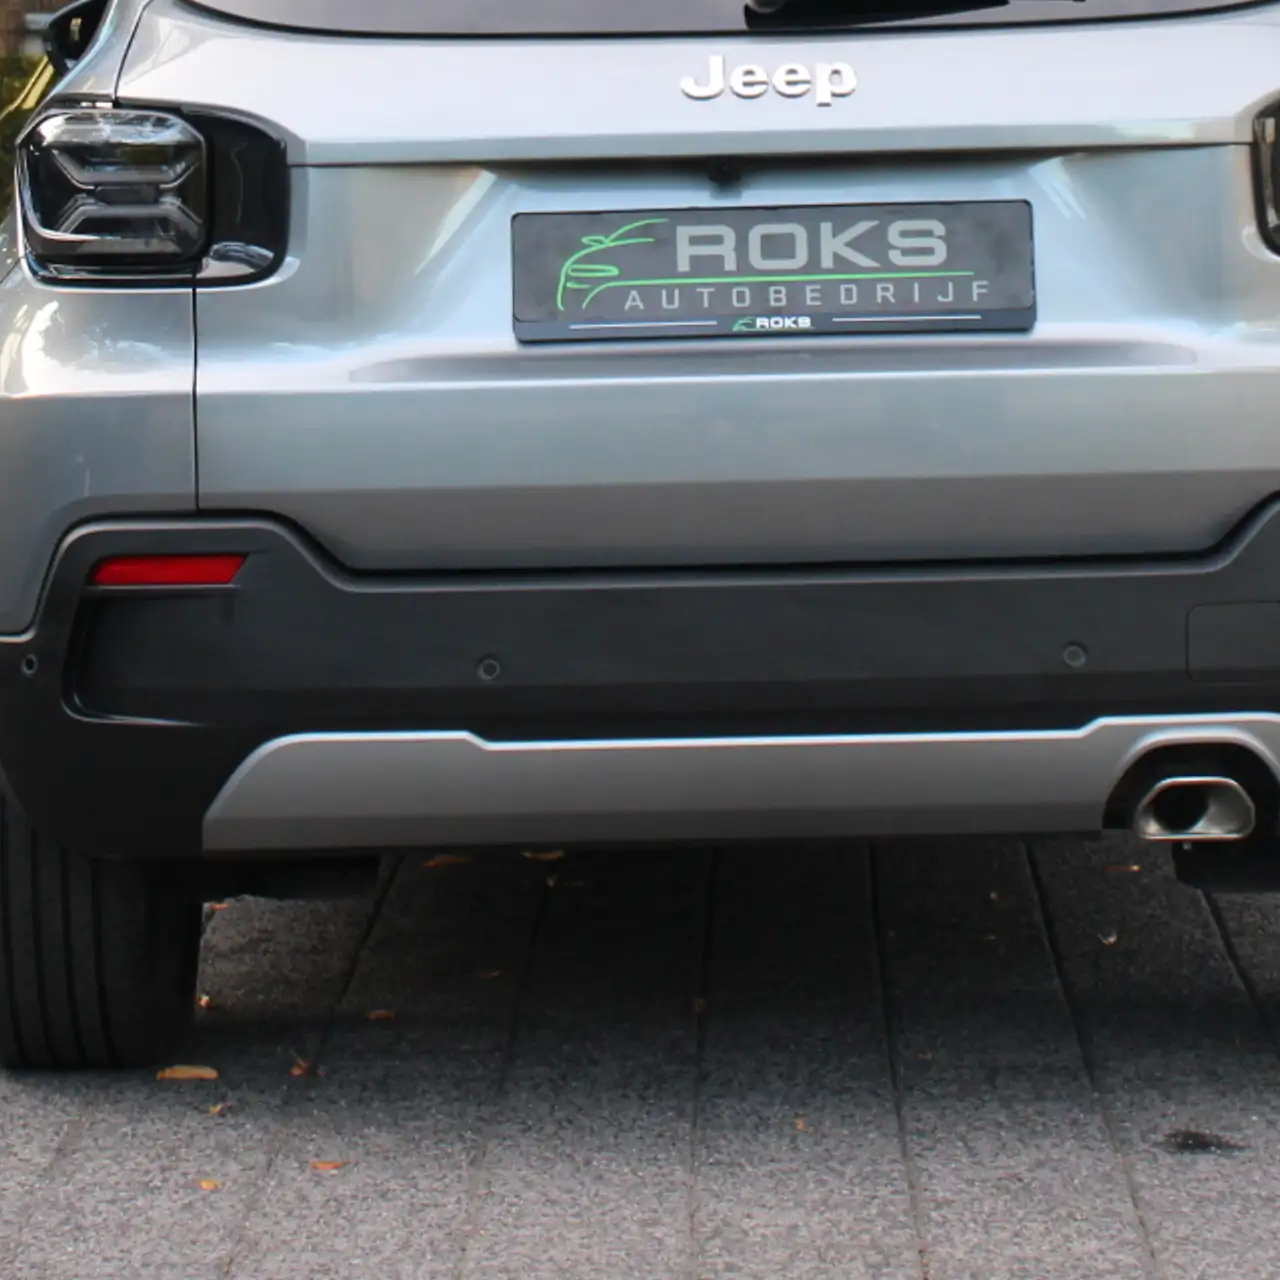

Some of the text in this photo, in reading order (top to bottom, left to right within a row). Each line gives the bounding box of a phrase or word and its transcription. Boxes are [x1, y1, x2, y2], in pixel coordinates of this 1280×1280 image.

[679, 54, 857, 107] Jeep
[675, 218, 948, 273] ROKS
[624, 279, 991, 312] AUTOBEDRIJF
[755, 316, 811, 330] ROKS
